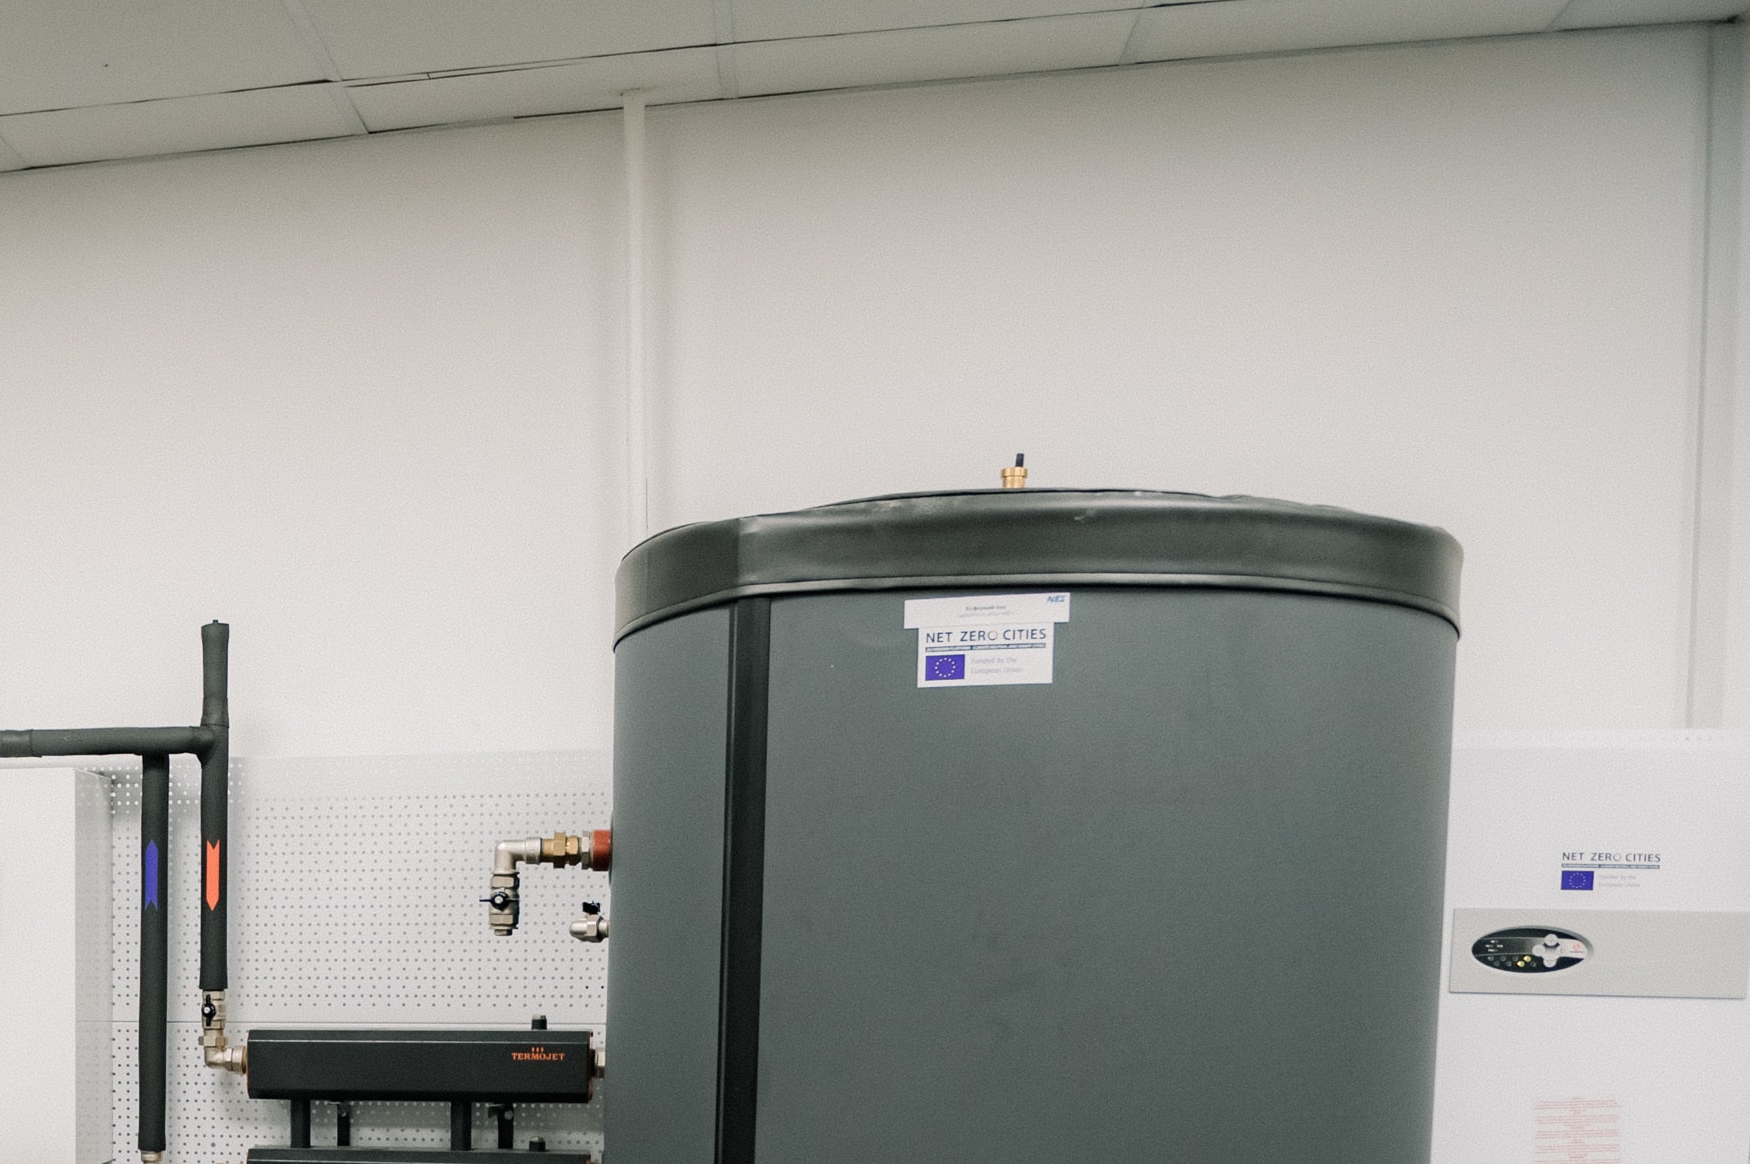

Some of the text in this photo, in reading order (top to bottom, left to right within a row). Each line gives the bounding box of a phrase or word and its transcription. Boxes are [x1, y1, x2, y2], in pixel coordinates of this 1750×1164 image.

[925, 628, 1047, 643] NET ZERO CITIES
[1562, 852, 1661, 862] NET ZERO CITIES
[511, 1052, 566, 1060] TERMOJET
